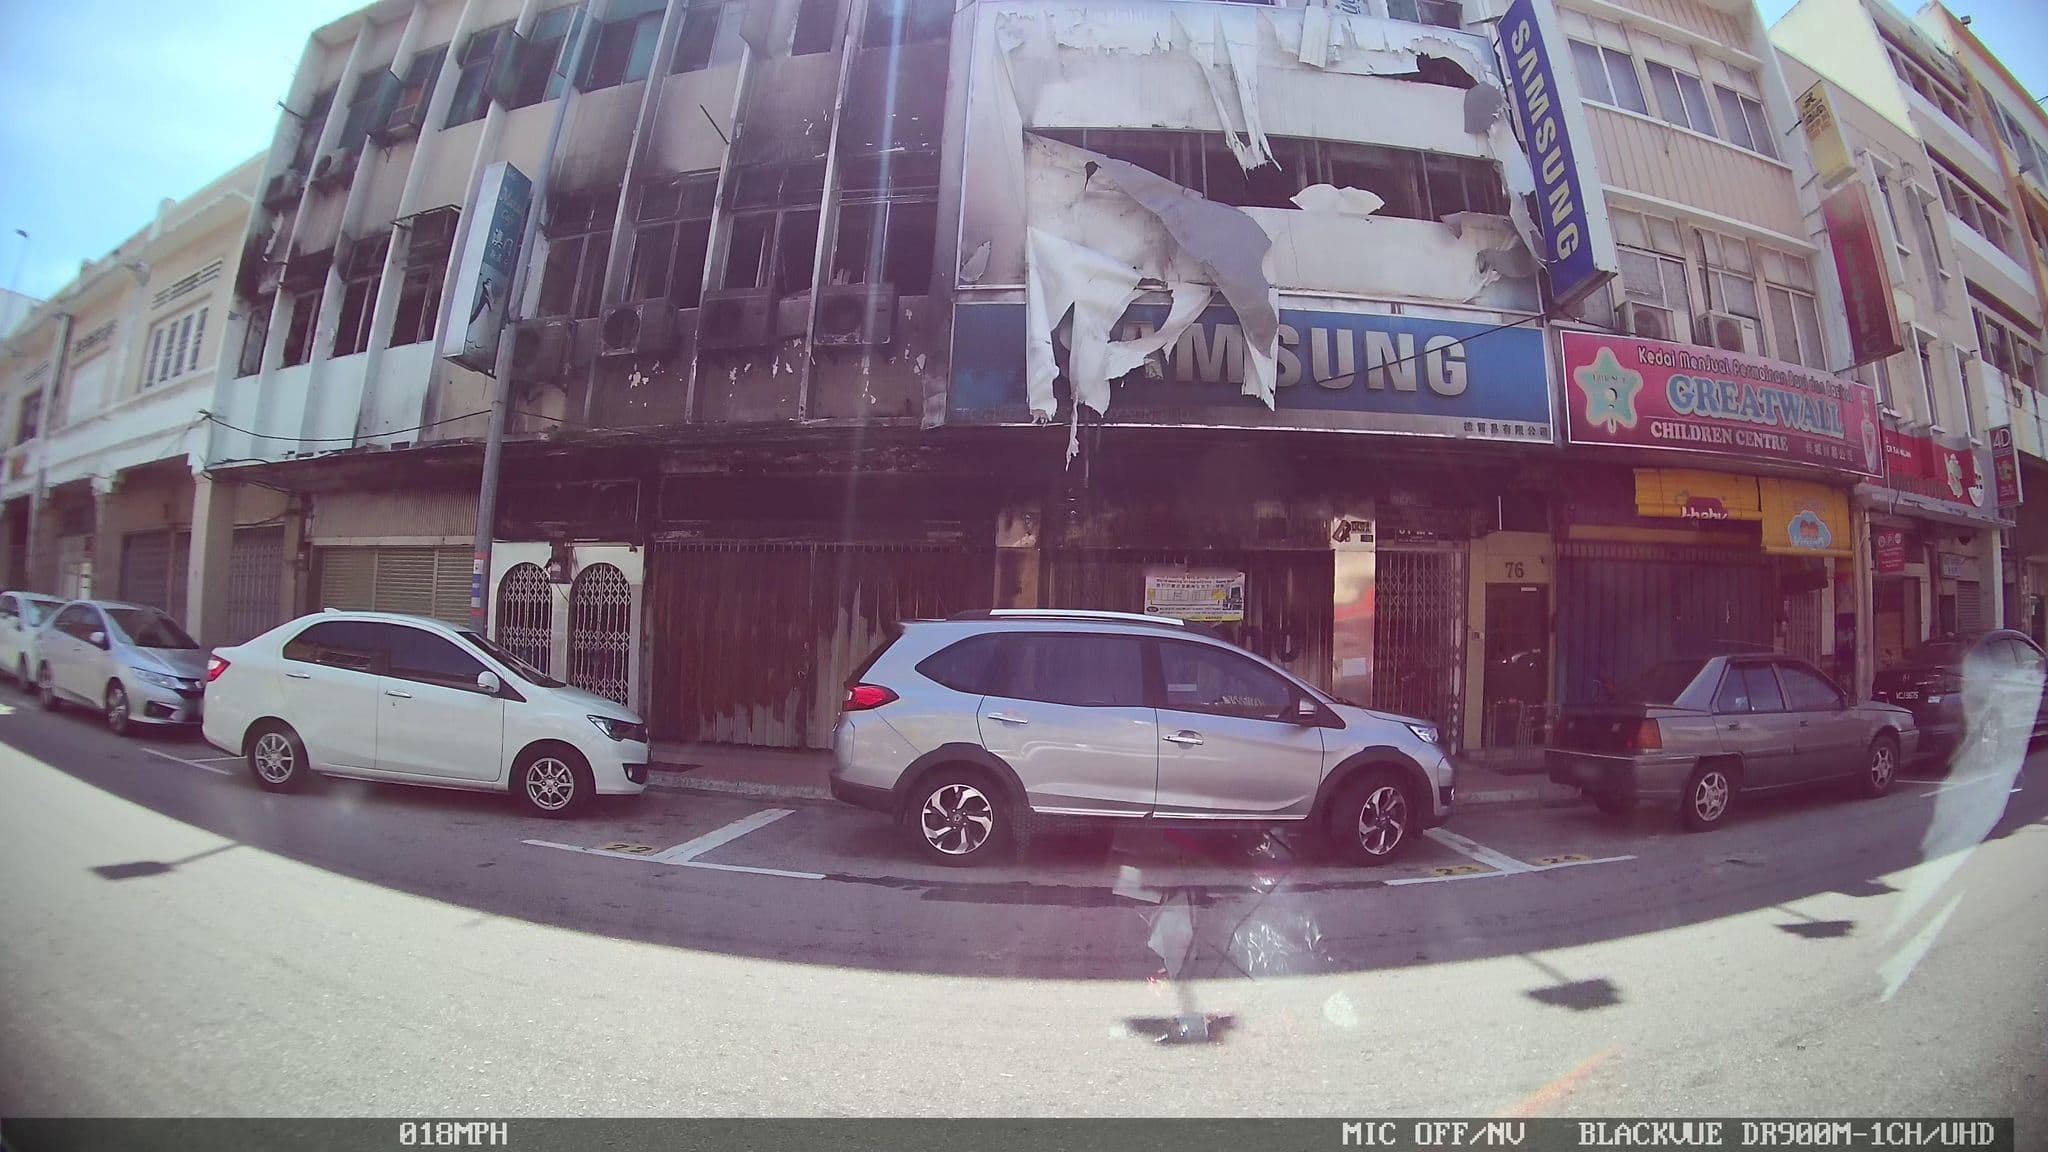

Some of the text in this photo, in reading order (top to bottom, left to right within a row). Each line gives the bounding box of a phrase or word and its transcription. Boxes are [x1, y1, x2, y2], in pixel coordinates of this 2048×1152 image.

[1511, 19, 1580, 261] SAMSUNG
[1637, 346, 1676, 368] Kedai
[1667, 375, 1845, 439] GREATWALL
[1650, 421, 1789, 452] CHILDREN CENTRE
[1993, 428, 2010, 448] 4D
[1505, 561, 1524, 578] 76
